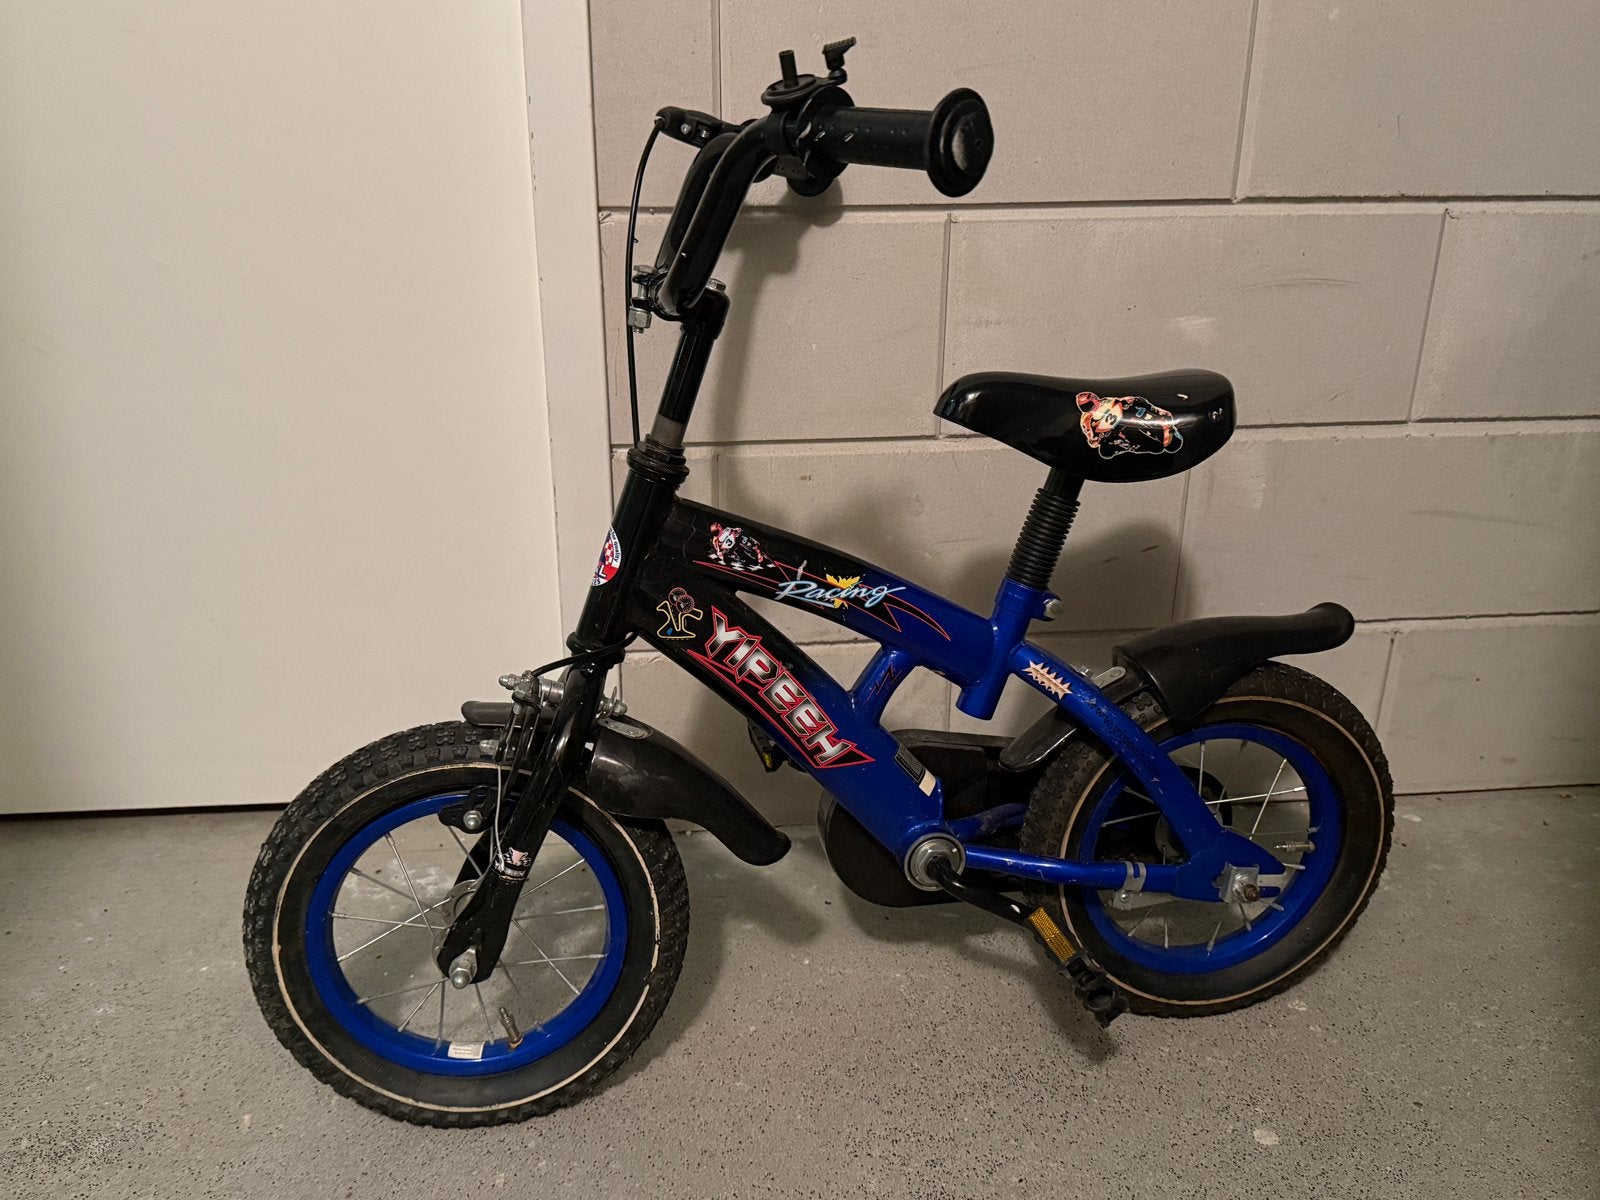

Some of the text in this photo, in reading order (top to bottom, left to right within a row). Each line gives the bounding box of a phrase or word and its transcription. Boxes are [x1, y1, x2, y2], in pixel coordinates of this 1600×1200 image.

[1105, 412, 1117, 425] 3
[726, 538, 733, 546] 3
[774, 580, 906, 608] Racing
[705, 607, 856, 766] YIPEEH
